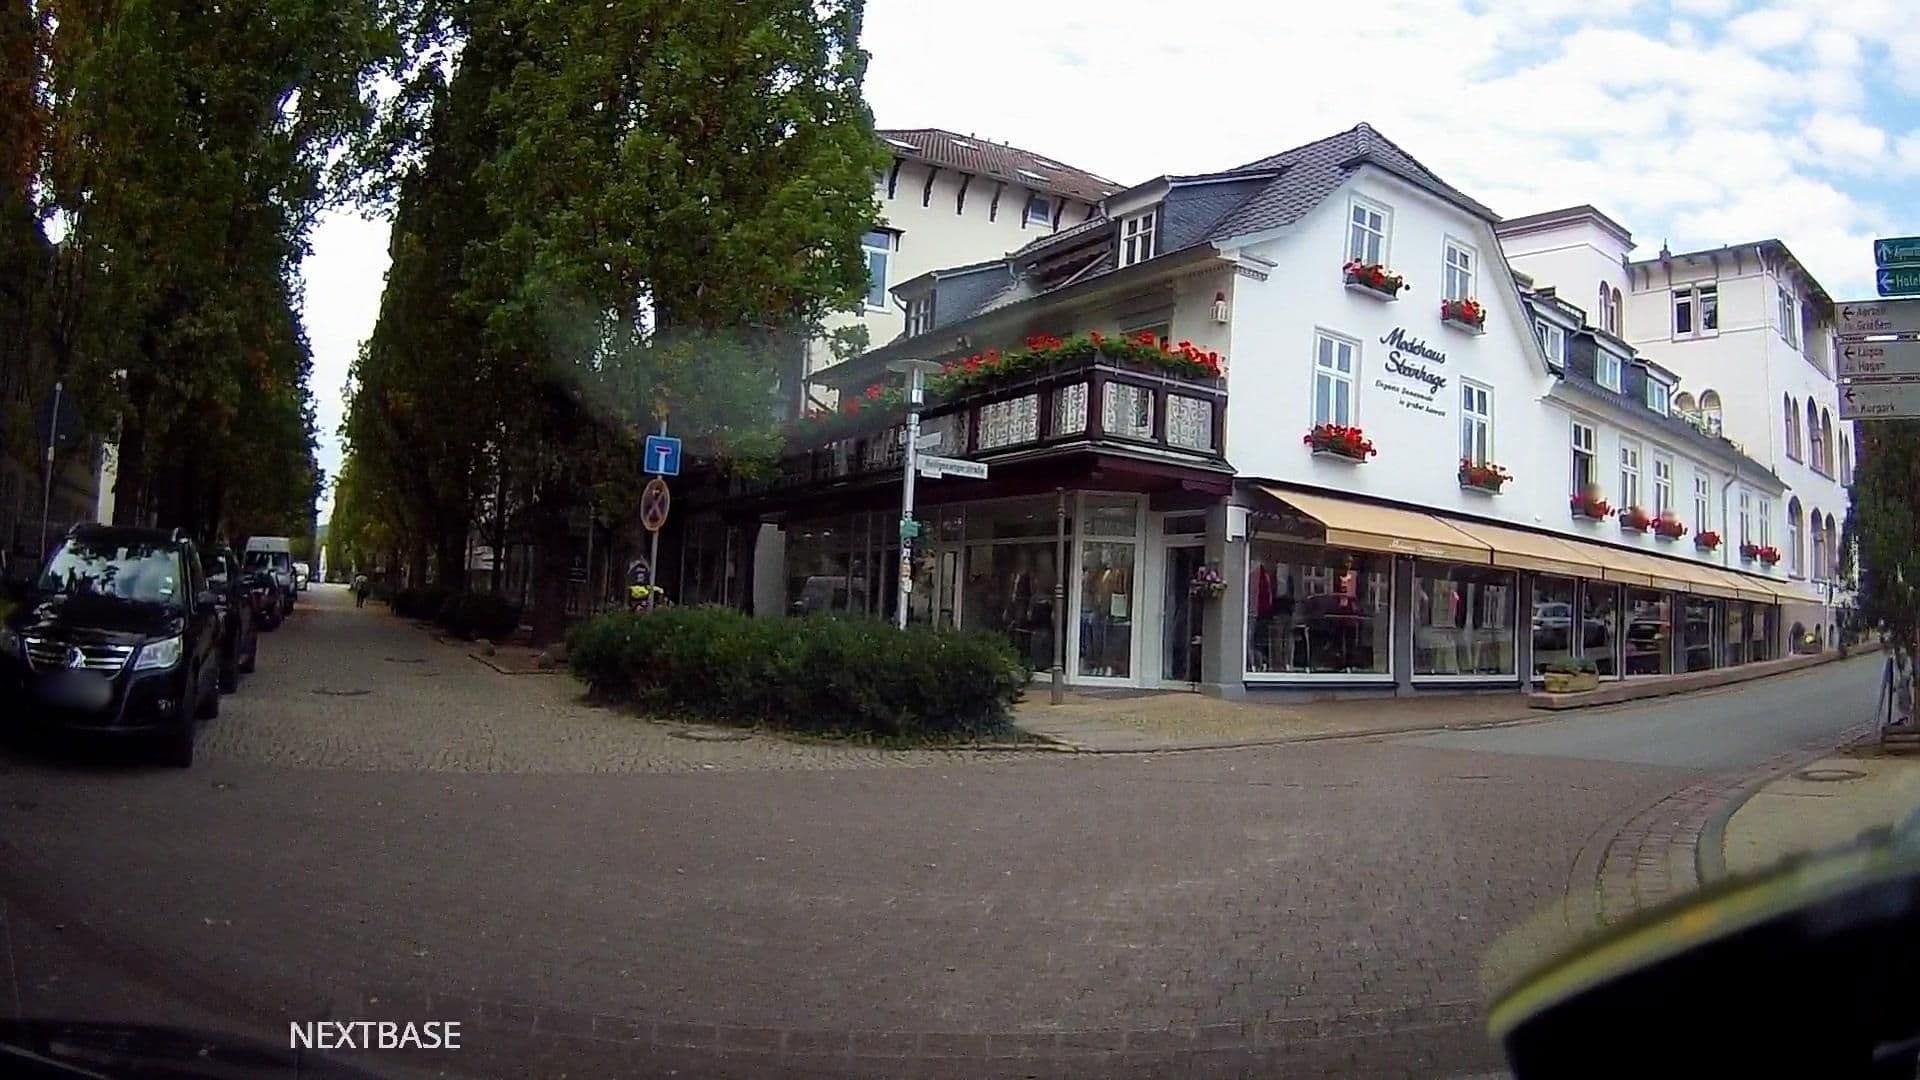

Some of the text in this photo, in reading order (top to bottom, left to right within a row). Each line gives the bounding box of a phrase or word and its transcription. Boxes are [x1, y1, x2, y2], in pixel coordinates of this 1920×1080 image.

[1379, 327, 1446, 364] Modehaus
[1385, 350, 1447, 394] Steinhage
[1860, 402, 1895, 414] Kurpark
